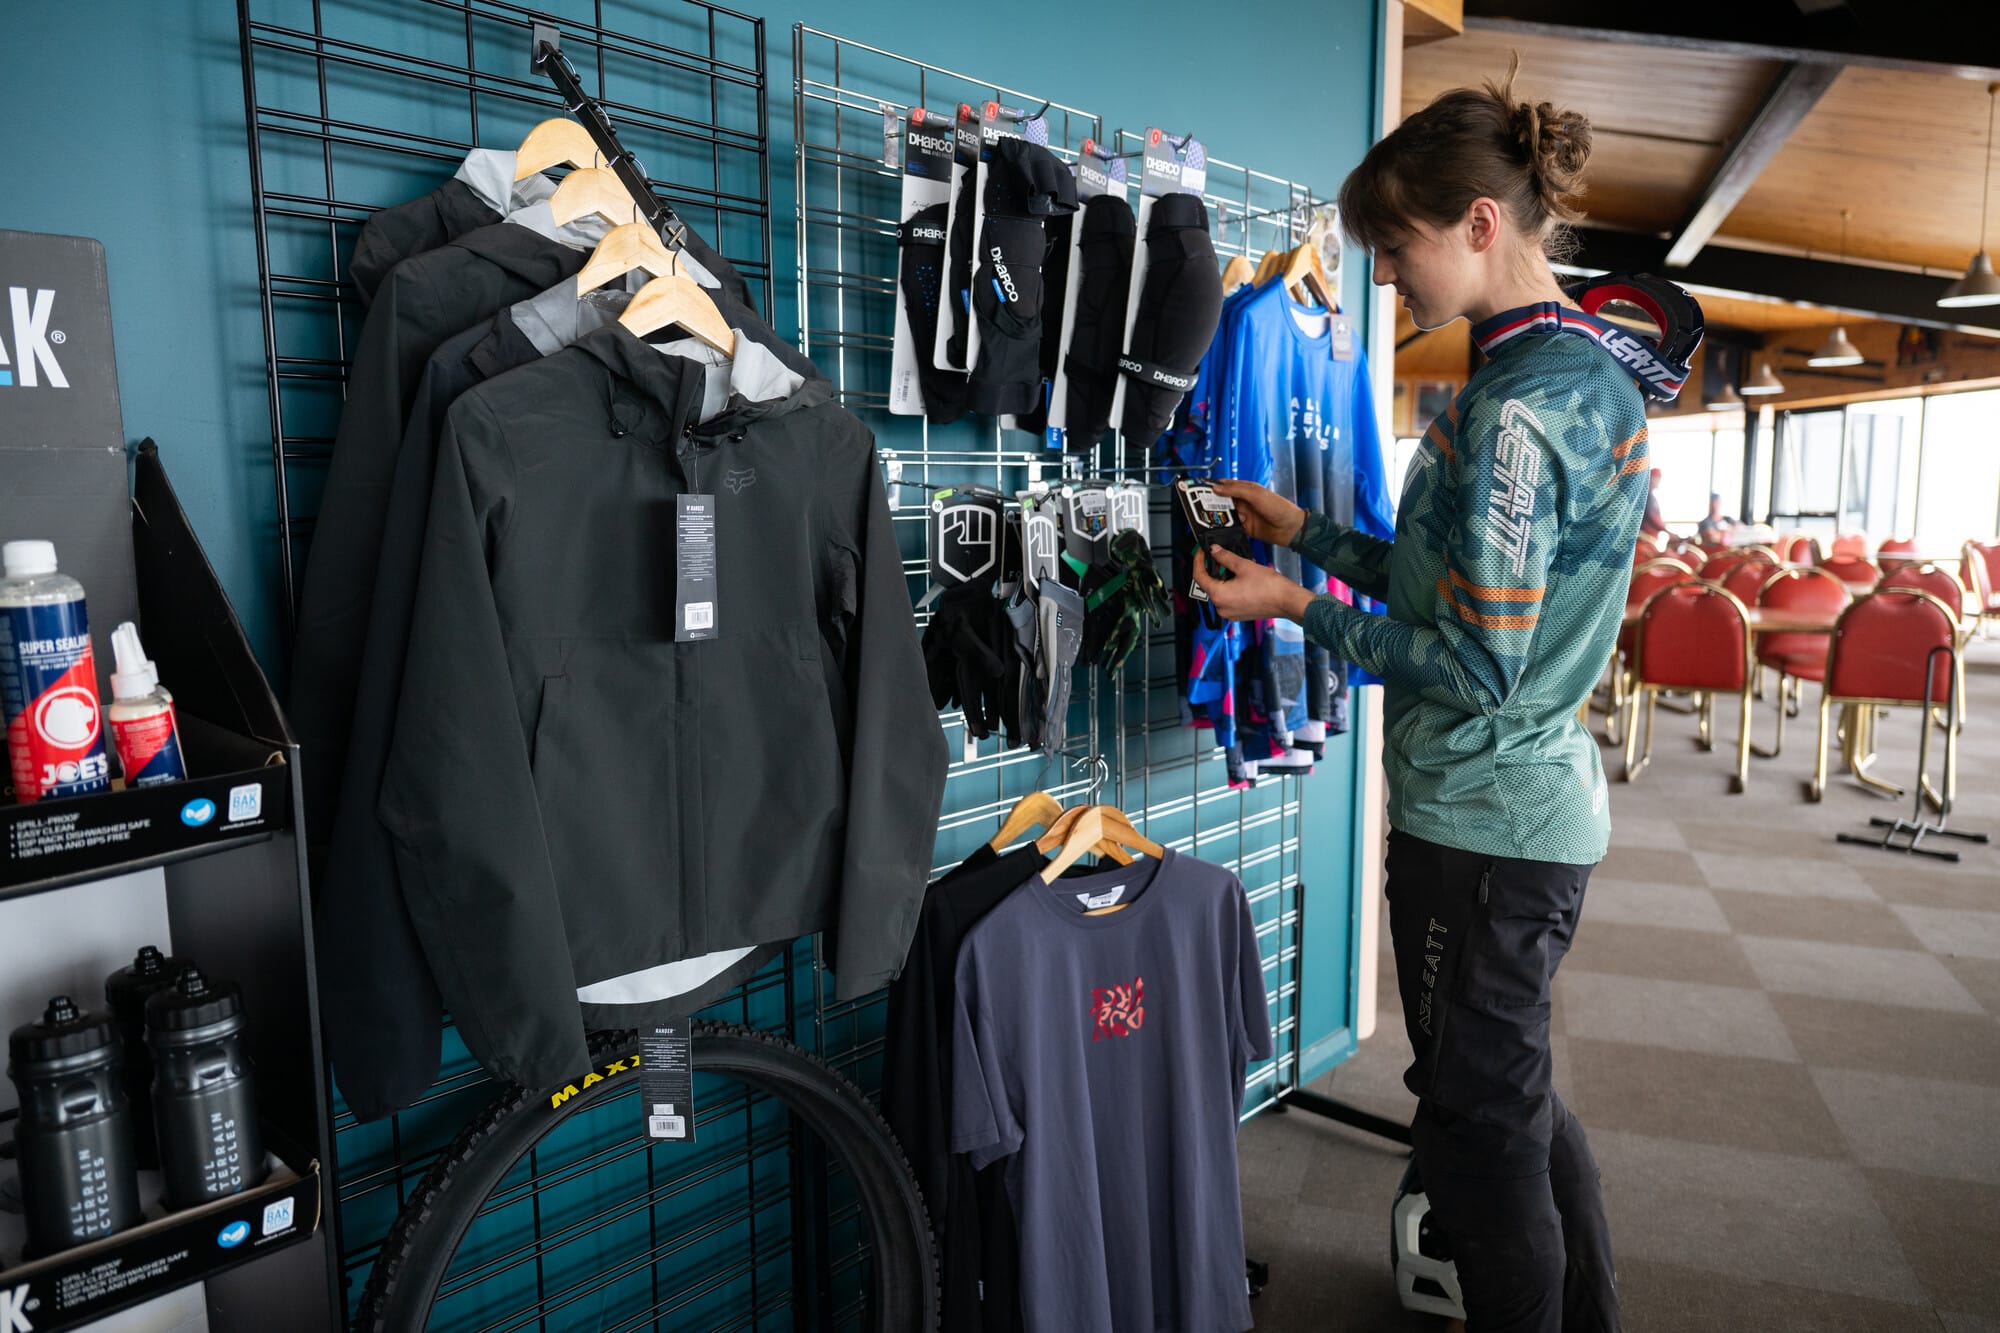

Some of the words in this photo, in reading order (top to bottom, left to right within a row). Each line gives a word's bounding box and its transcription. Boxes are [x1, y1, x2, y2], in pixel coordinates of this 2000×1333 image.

[913, 227, 947, 240] DHaRC
[0, 287, 70, 388] K
[1600, 328, 1682, 387] LEATT
[1486, 398, 1546, 579] LEATT
[19, 639, 54, 655] SUPER
[233, 793, 256, 808] BAK
[17, 829, 41, 840] EASY
[43, 823, 75, 836] CLEAN
[18, 838, 37, 849] TOP
[38, 833, 65, 845] RACK
[65, 822, 127, 841] DISHWASHER
[127, 819, 151, 831] SAFE
[18, 847, 43, 859] 100%
[44, 843, 64, 854] BPA
[64, 839, 86, 851] AND
[87, 836, 106, 847] BPS
[107, 832, 131, 843] FREE
[1421, 917, 1449, 1004] LEATT
[211, 1112, 231, 1191] TERRAIN
[225, 1119, 242, 1186] CYCLES
[78, 1148, 98, 1234] TERRAIN
[94, 1156, 111, 1229] CYCLES
[205, 1160, 219, 1192] ALL
[71, 1201, 86, 1237] ALL
[82, 1280, 108, 1293] RACK
[108, 1258, 166, 1285] DISHWASHER
[167, 1250, 189, 1262] SAFE
[87, 1269, 118, 1284] CLEAN
[107, 1281, 128, 1293] AND
[147, 1264, 170, 1278] FREE
